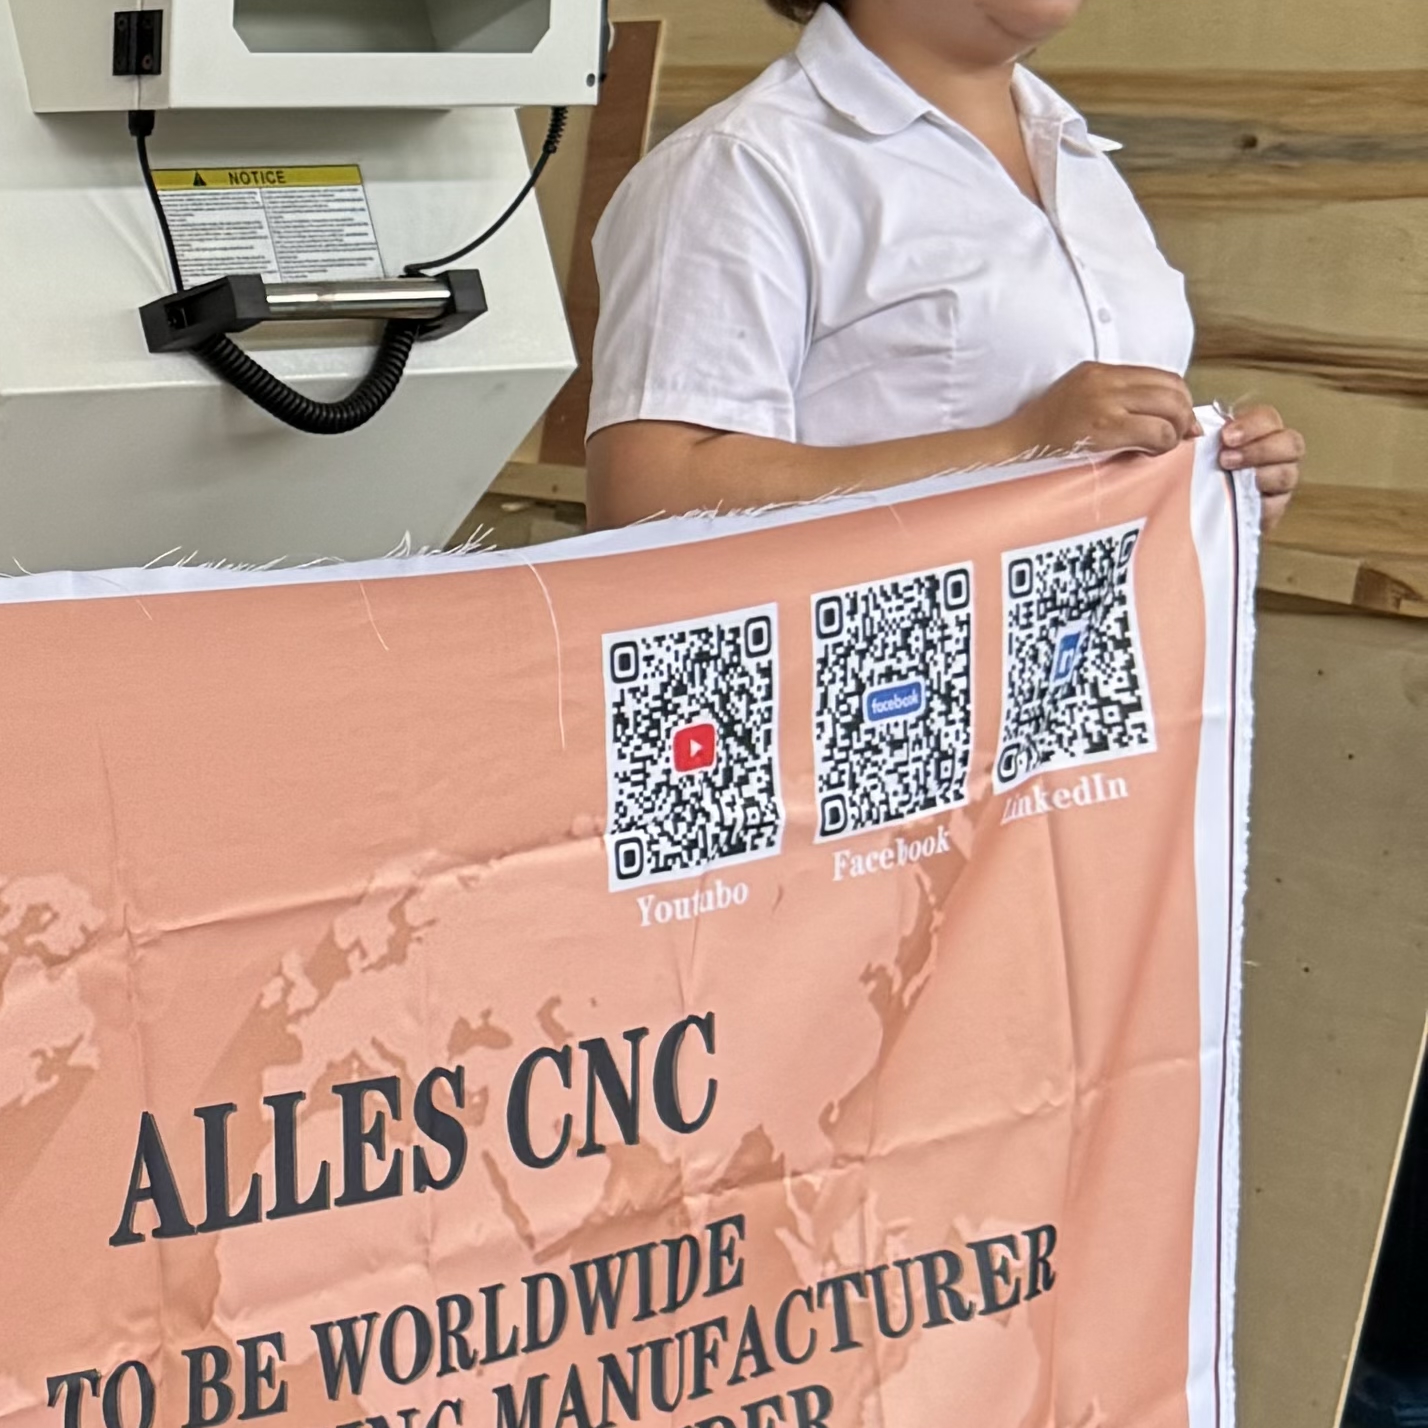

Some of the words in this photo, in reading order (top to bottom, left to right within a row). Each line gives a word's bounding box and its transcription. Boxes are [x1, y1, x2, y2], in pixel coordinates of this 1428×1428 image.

[228, 170, 286, 185] NOTICE
[832, 824, 951, 881] Facebook
[110, 1065, 469, 1247] ALLES
[505, 1013, 720, 1170] CNC
[310, 1215, 746, 1402] WORLDWIDE
